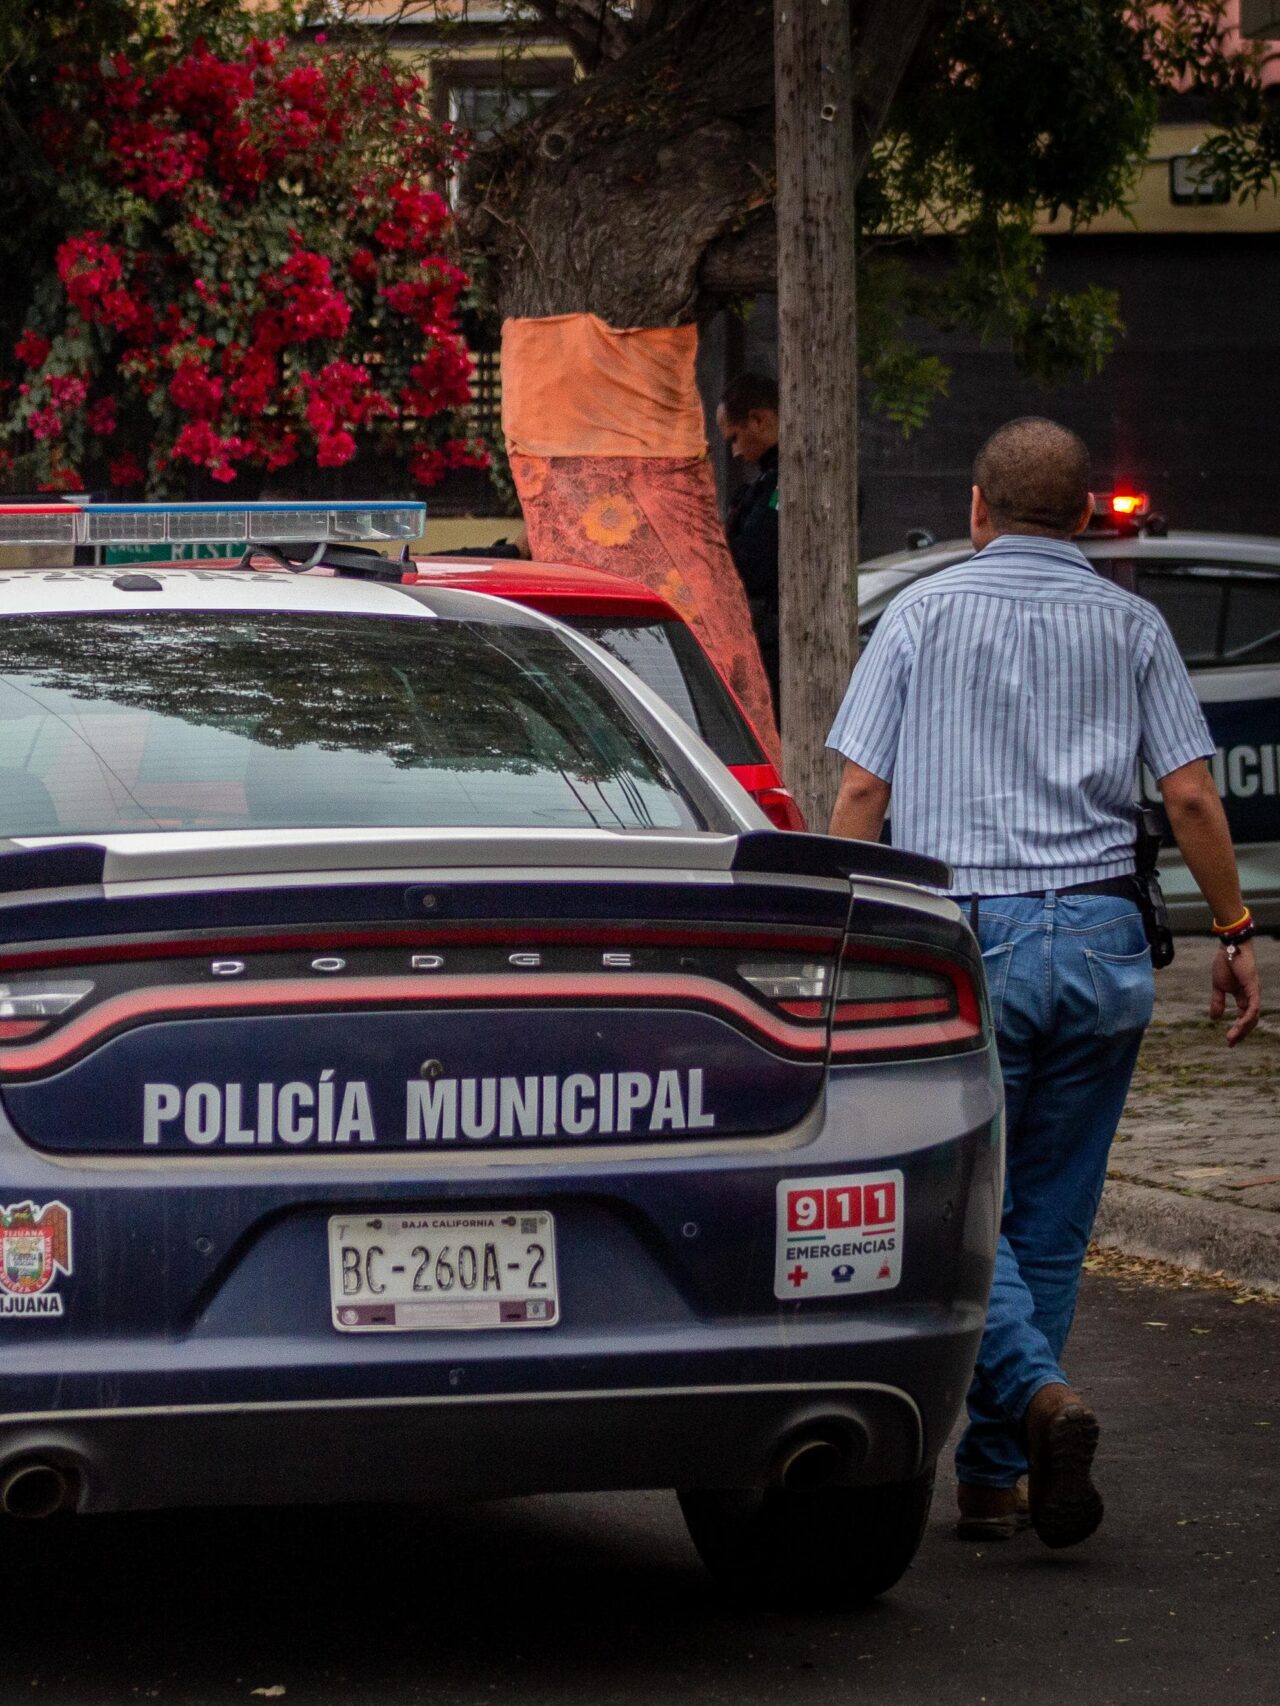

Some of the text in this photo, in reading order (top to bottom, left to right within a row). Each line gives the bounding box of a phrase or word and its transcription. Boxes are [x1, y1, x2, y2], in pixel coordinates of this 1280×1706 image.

[211, 952, 632, 975] DODGE
[142, 1068, 715, 1145] POLICÍA MUNICIPAL
[795, 1188, 886, 1226] 911
[401, 1218, 495, 1229] BAJA CALIFORNIA
[786, 1238, 896, 1260] EMERGENCIAS
[341, 1243, 548, 1296] BC-260A-2
